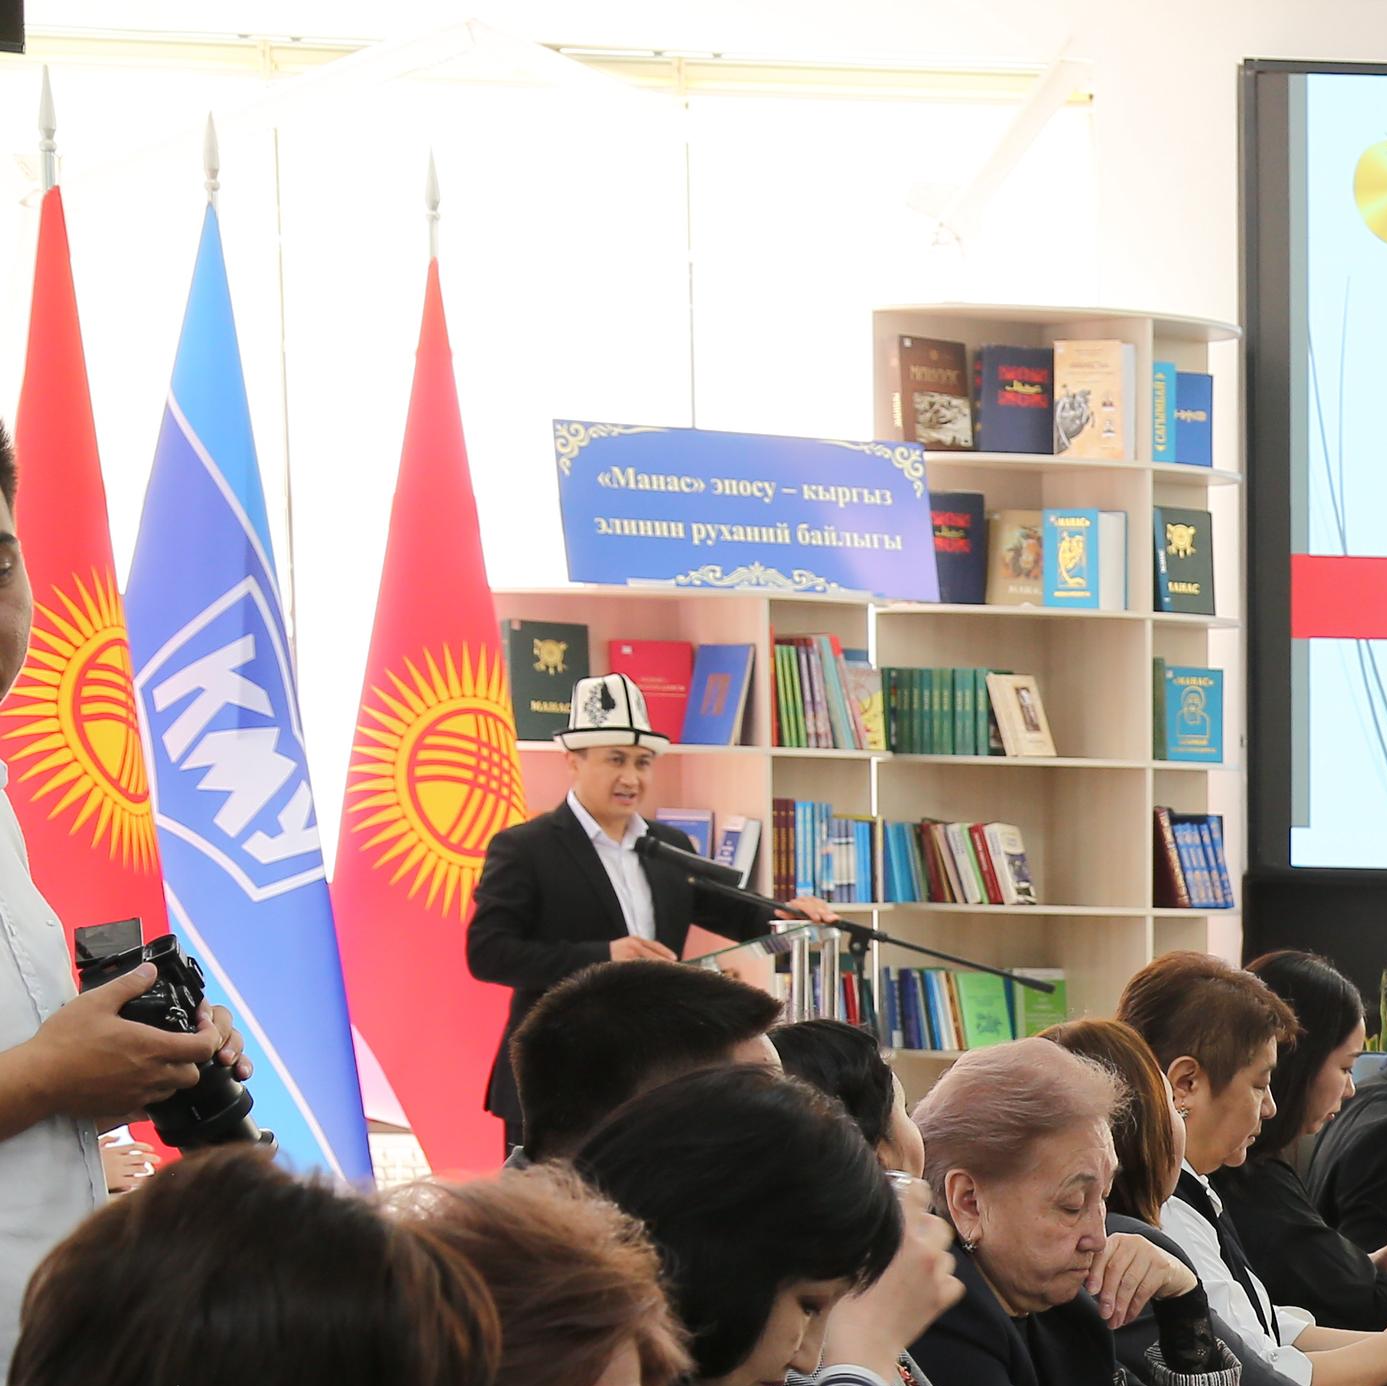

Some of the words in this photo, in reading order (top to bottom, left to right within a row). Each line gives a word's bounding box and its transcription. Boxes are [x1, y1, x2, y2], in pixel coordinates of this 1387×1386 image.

[597, 465, 705, 494] «Манас»
[711, 477, 777, 503] эпосу
[802, 482, 893, 508] кыргыз
[594, 516, 686, 539] элинин
[691, 521, 792, 546] руханий
[796, 522, 903, 551] байлыгы
